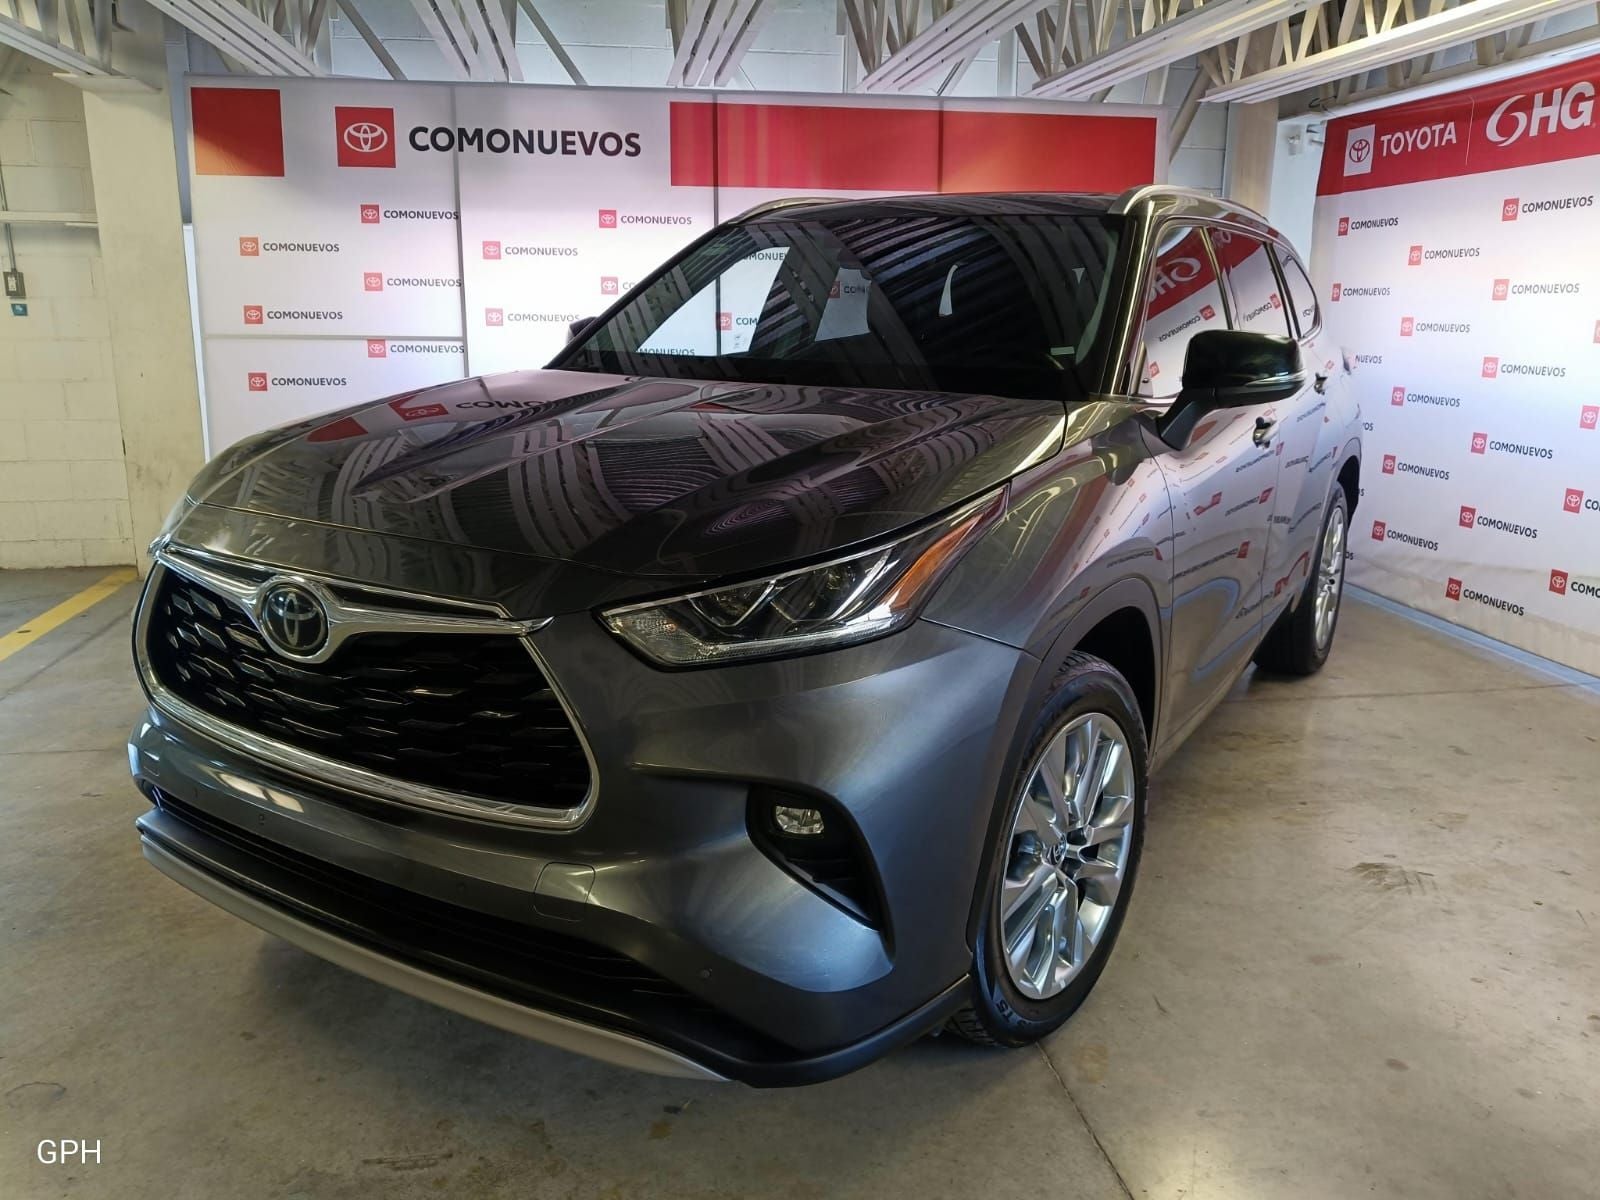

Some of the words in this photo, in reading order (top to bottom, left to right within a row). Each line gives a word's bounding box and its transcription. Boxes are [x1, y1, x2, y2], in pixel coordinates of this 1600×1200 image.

[408, 126, 642, 157] COMONUEVOS
[1380, 121, 1457, 157] TOYOTA
[1521, 195, 1594, 213] COMONUEVOS
[383, 209, 459, 220] COMONUEVOS
[620, 215, 692, 225] COMONUEVOS
[1350, 216, 1399, 231] COMONUEVOS
[262, 242, 340, 253] COMONUEVOS
[504, 246, 579, 257] COMONUEVOS
[1424, 247, 1481, 260] COMONUEVOS
[386, 277, 462, 288] COMONUEVOS
[1511, 282, 1580, 295] COMONUEVOS
[1342, 286, 1391, 298] COMONUEVOS
[266, 310, 343, 320] COMONUEVOS
[1415, 322, 1471, 334] COMONUEVOS
[390, 343, 465, 354] COMONUEVOS
[1354, 354, 1383, 365] NUEVOS
[1500, 363, 1566, 378] COMONUEVOS
[271, 377, 347, 387] COMONUEVOS
[1406, 393, 1461, 408] COMONUEVOS
[1489, 440, 1553, 460] COMONUEVOS
[1397, 462, 1450, 481] COMONUEVOS
[1477, 515, 1538, 539] COMONUEVOS
[1386, 529, 1439, 552] COMONUEVOS
[1463, 588, 1525, 617] COMONUEVOS
